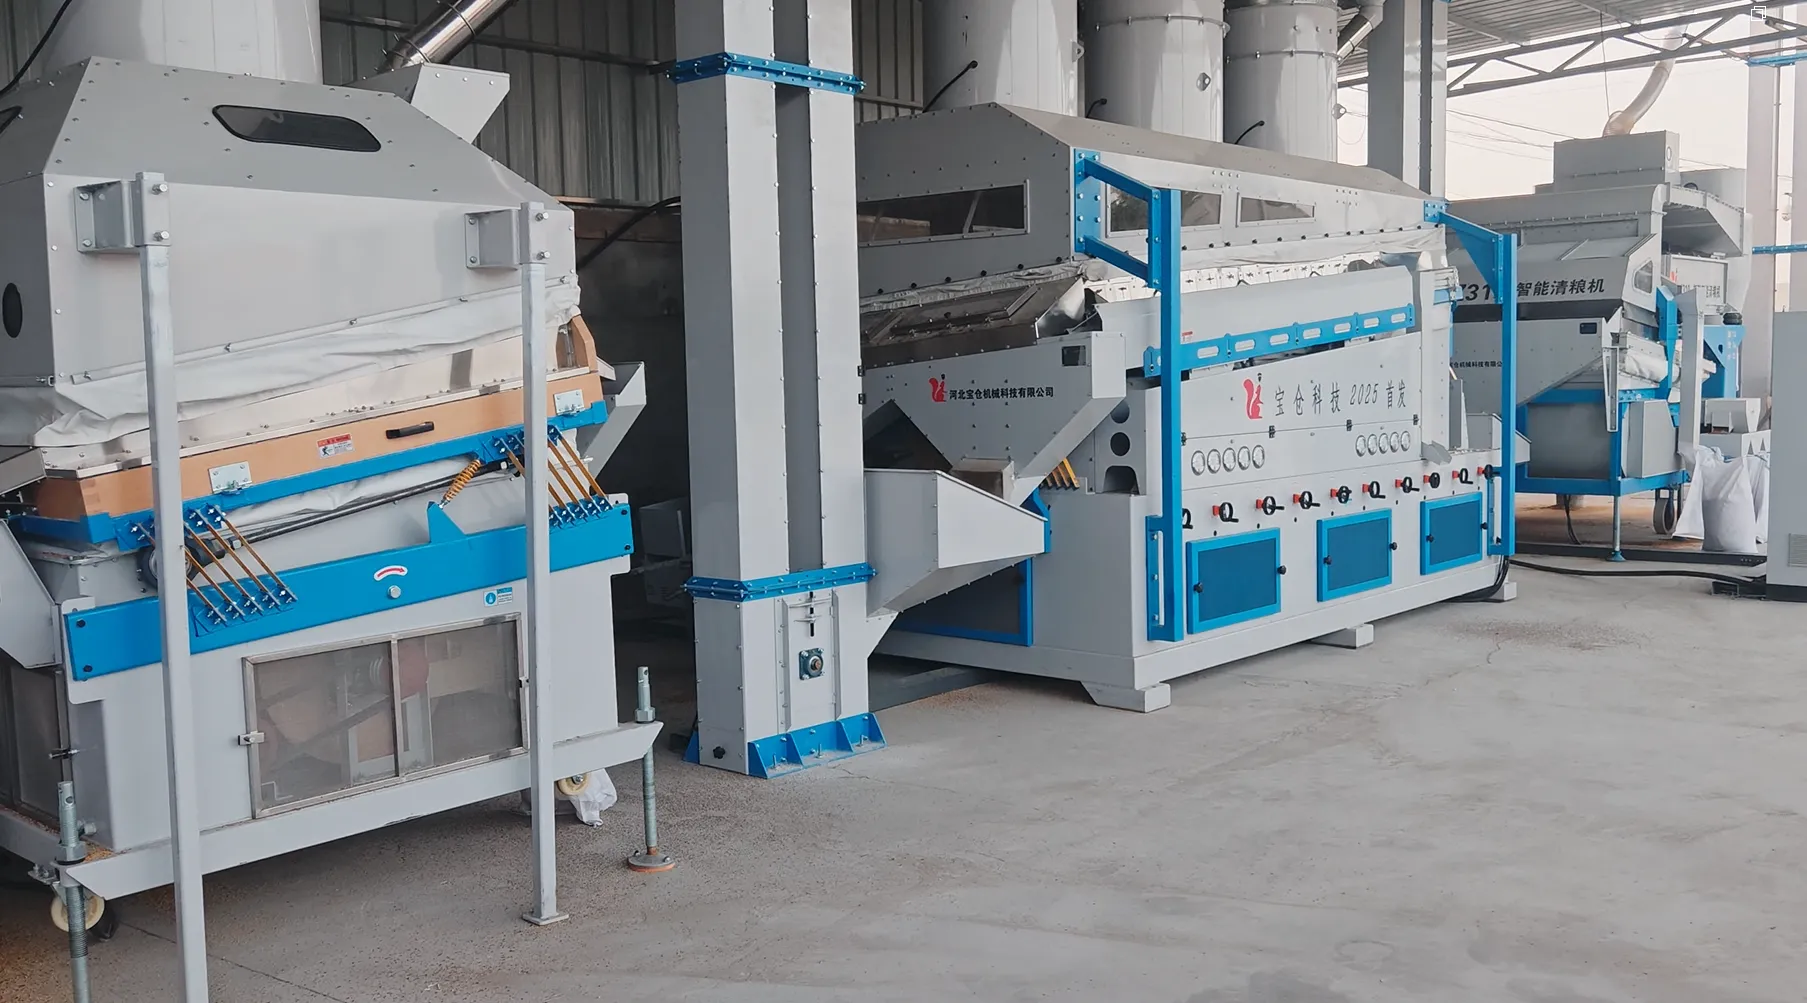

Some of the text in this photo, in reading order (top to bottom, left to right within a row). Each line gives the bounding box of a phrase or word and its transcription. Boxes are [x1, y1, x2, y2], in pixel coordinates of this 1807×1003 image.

[1516, 278, 1605, 297] 智能清粮机
[949, 386, 1054, 400] 河北宝仓机械科技有限公司
[1275, 379, 1406, 416] 宝仓科技 2025 首发
